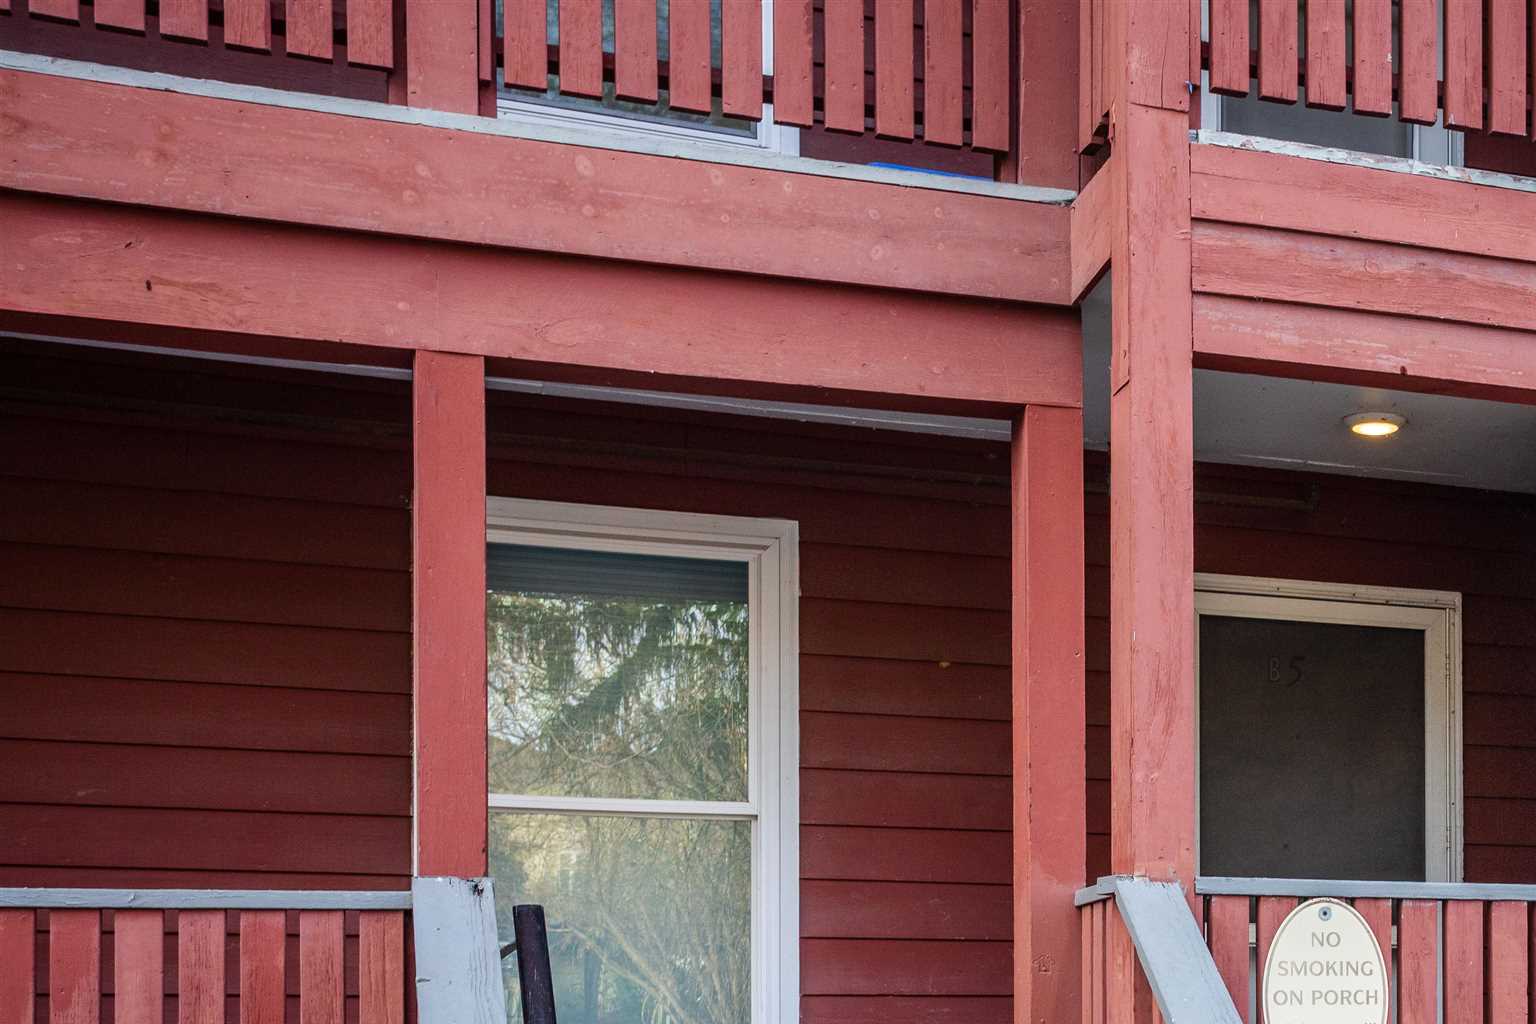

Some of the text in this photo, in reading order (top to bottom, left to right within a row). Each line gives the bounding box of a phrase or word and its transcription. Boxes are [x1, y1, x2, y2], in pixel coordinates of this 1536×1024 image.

[1311, 932, 1341, 948] NO
[1277, 960, 1374, 977] SMOKING
[1273, 989, 1378, 1006] ON PORCH
